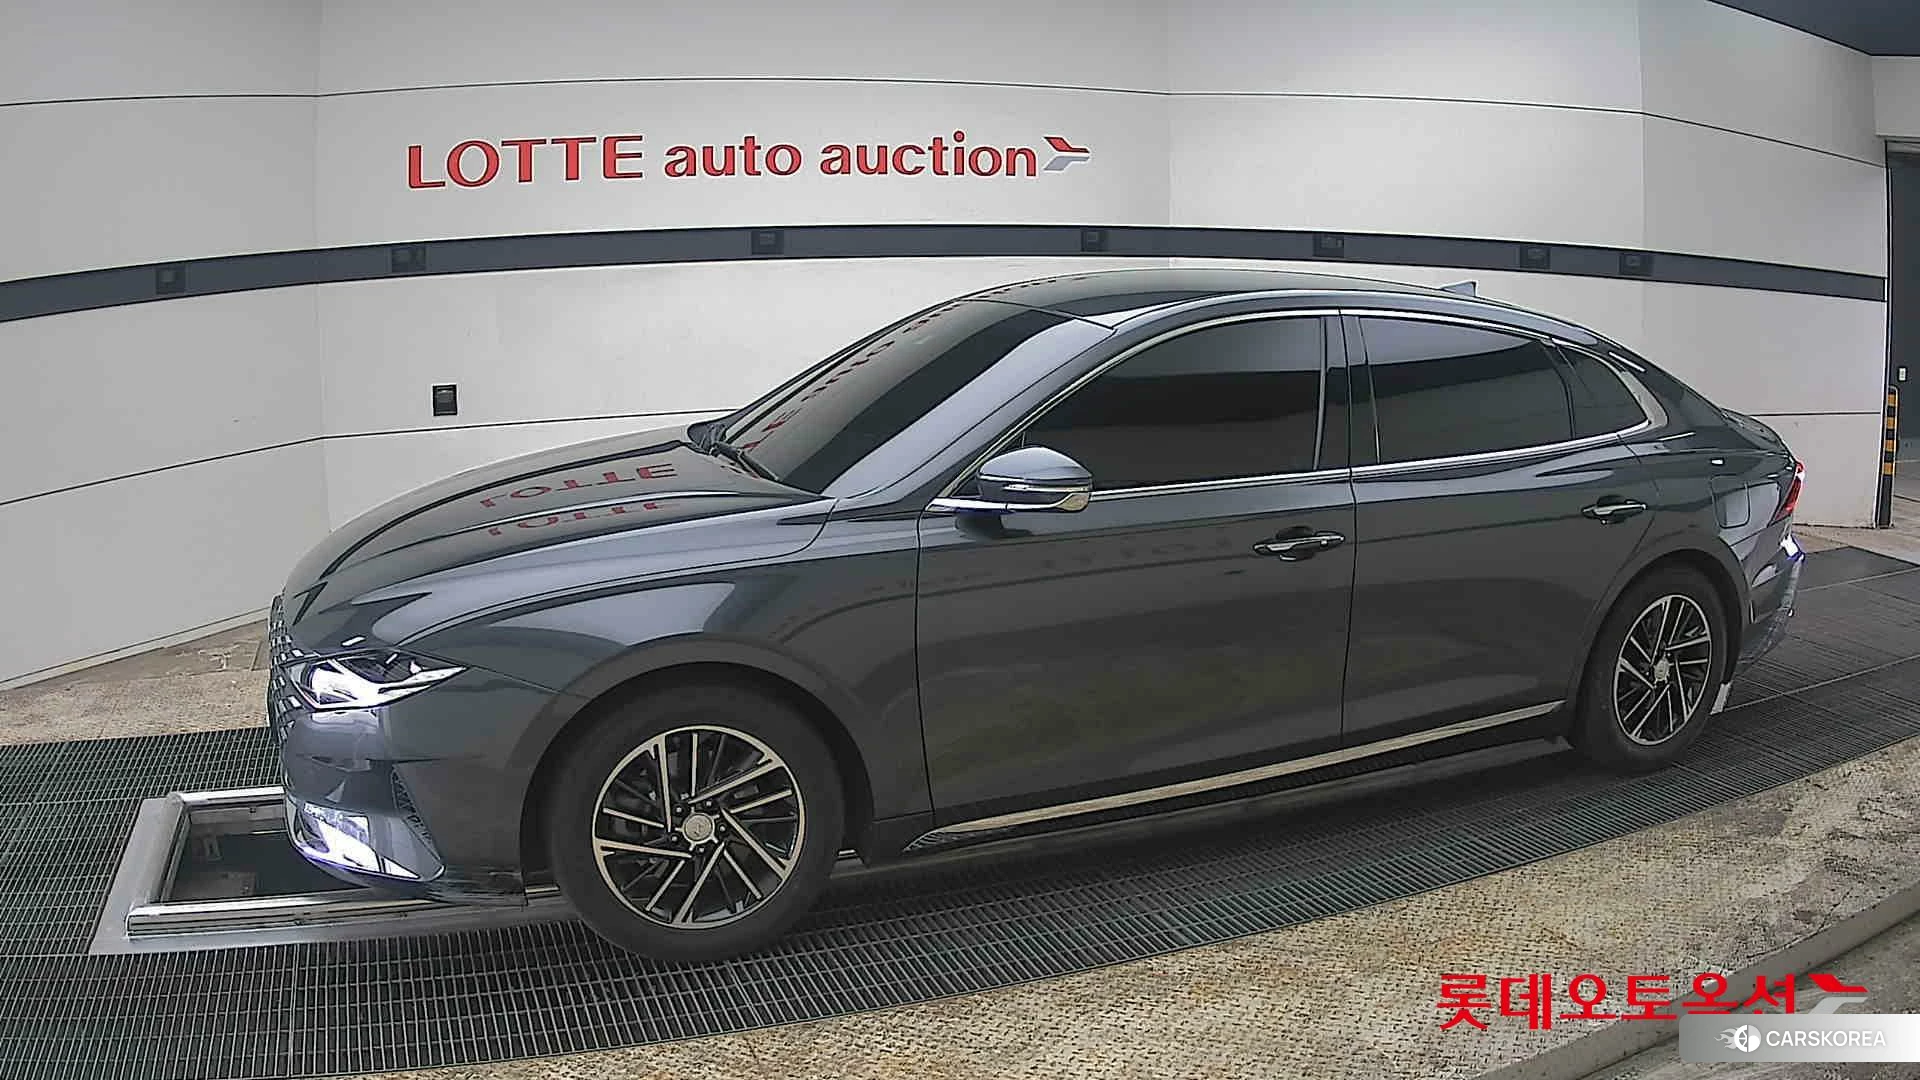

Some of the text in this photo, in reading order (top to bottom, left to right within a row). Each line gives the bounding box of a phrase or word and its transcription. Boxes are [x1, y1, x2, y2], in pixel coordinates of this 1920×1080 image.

[407, 130, 1038, 189] LOTTE auto auction
